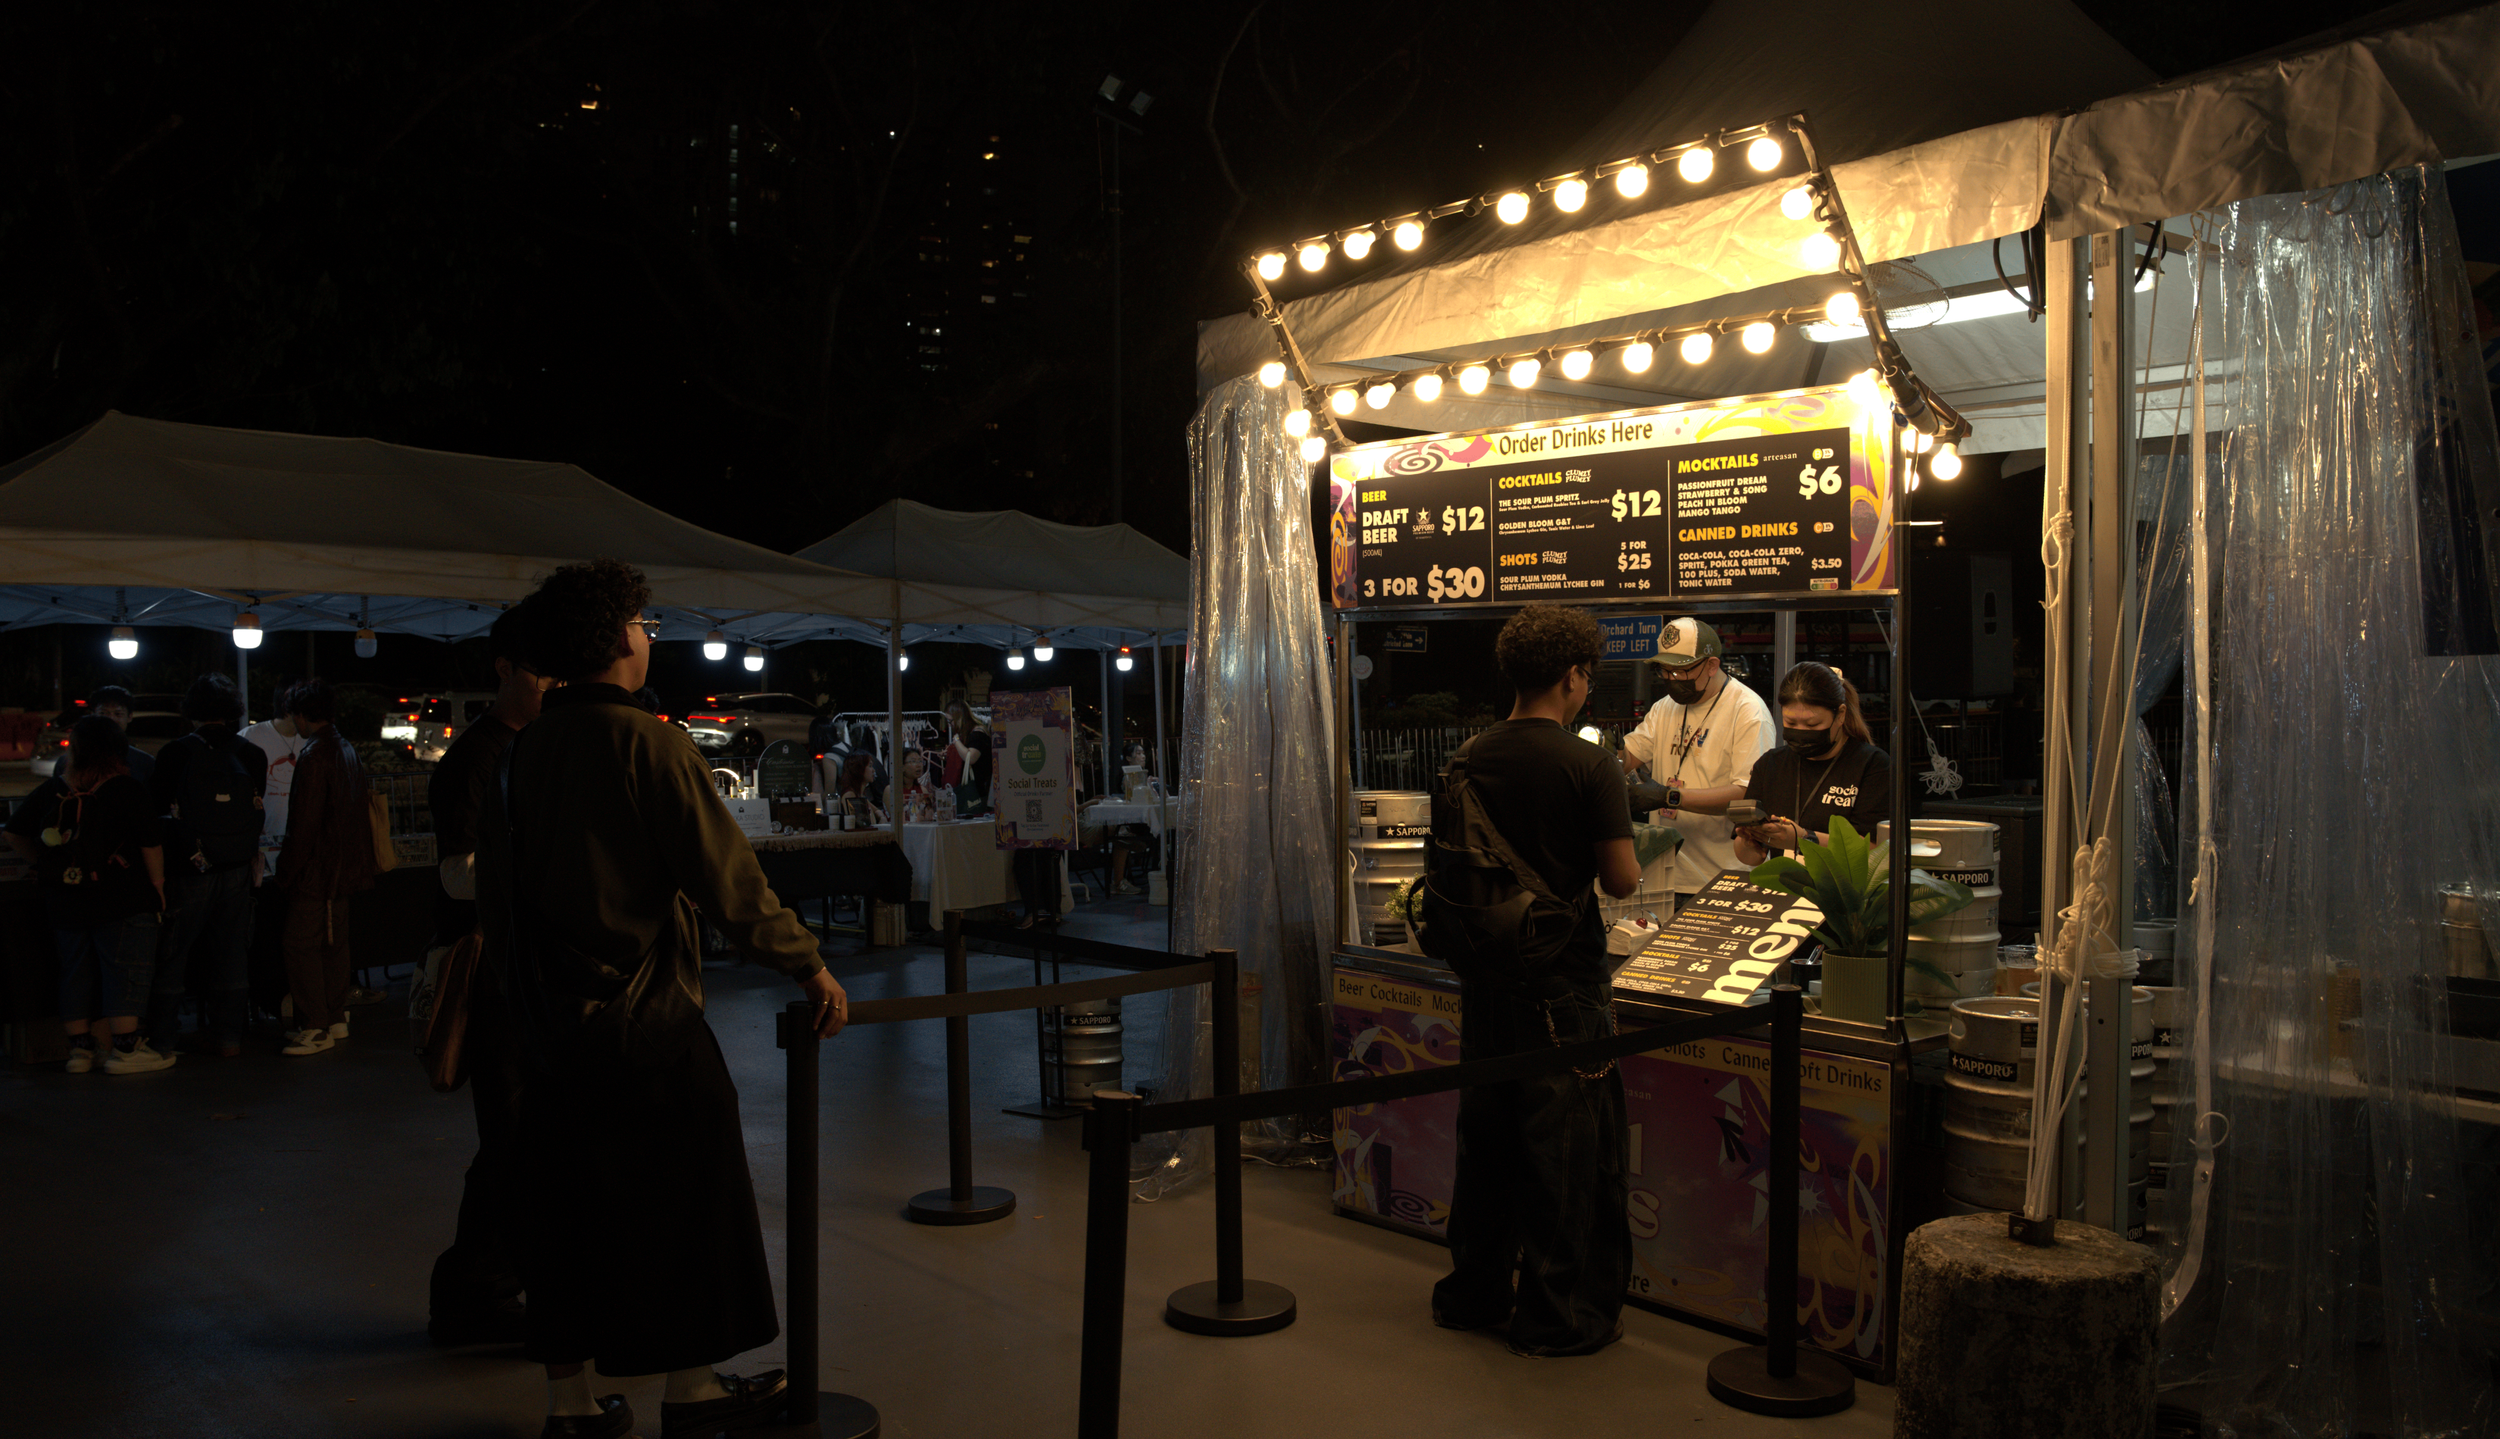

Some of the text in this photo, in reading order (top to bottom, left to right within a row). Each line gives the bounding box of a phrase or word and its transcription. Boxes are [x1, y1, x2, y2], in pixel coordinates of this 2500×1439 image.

[1500, 421, 1653, 455] Order Drinks Here
[1677, 453, 1798, 474] MOCKTAILS arteasan
[1565, 469, 1592, 478] CLUMZY
[1565, 475, 1591, 483] PLUMZY
[1498, 471, 1563, 490] COCKTAILS
[1677, 475, 1767, 491] PASSIONFRUIT DREAM
[1799, 463, 1842, 501] $6
[1362, 490, 1387, 503] BEER
[1677, 485, 1768, 500] STRAWBERRY & SONG
[1499, 493, 1580, 508] THE SOUR PLUM SPRITZ
[1611, 489, 1662, 522] $12
[1677, 496, 1748, 509] PEACH IN BLOOM
[1362, 508, 1409, 527] DRAFT
[1677, 506, 1741, 518] MANGO TANGO
[1442, 505, 1485, 536] $12
[1499, 517, 1571, 531] GOLDEN BLOOM G&T
[1412, 523, 1435, 532] SAPPORO
[1678, 522, 1799, 543] CANNED DRINKS
[1362, 527, 1398, 545] BEER
[1620, 541, 1647, 550] 5 FOR
[1362, 549, 1382, 558] (500ML)
[1500, 553, 1538, 566] SHOTS
[1678, 546, 1804, 561] COCA-COLA, COCA-COLA ZERO,
[1617, 552, 1652, 573] $25
[1678, 557, 1790, 570] SPRITE, POKKA GREEN TEA,
[1811, 557, 1842, 571] $3.50
[1679, 567, 1781, 579] 100 PLUS, SODA WATER,
[1364, 564, 1485, 603] 3 FOR $30
[1500, 579, 1604, 591] CHRYSANTHEMUM LYCHEE GIN
[1638, 579, 1650, 590] $6
[1679, 578, 1733, 588] TONIC WATER
[1601, 622, 1657, 636] Orchard Turn
[1606, 639, 1650, 653] KEEP LEFT
[1008, 777, 1057, 789] Social Treats
[1829, 784, 1859, 796] socia
[1715, 880, 1748, 888] DRAFT
[1942, 872, 1989, 884] SAPPORO
[1707, 899, 1732, 908] FOR
[1734, 899, 1773, 913] $30
[1682, 911, 1718, 920] COCKTAILS
[1731, 925, 1760, 936] $12
[1718, 943, 1739, 951] $25
[1641, 950, 1680, 959] MOCKTAILS
[1687, 961, 1710, 973] $6
[1621, 971, 1676, 983] CANNED DRINKS
[1339, 978, 1462, 1014] Beer Cocktails Mock
[1080, 1016, 1111, 1025] SAPPORO
[1722, 1046, 1770, 1072] Canne
[1959, 1058, 2012, 1077] SAPPORO
[1799, 1061, 1882, 1093] oft Drinks
